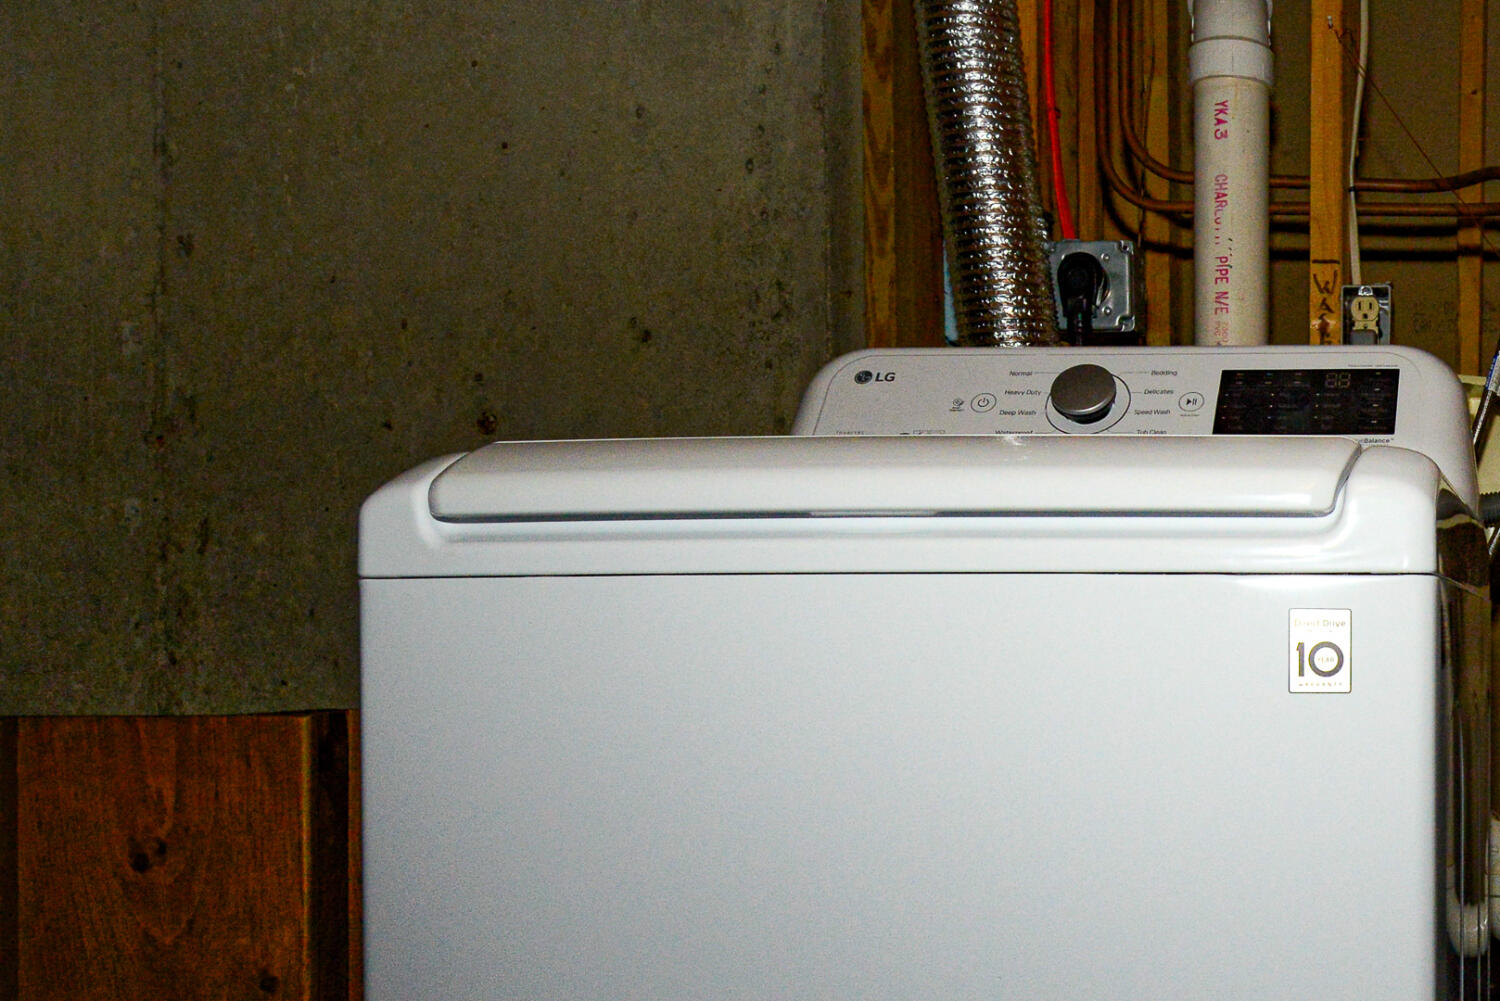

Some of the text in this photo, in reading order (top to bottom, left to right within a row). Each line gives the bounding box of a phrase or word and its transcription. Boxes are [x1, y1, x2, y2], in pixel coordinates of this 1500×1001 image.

[1214, 255, 1229, 285] PIPE
[874, 371, 896, 382] LG
[1296, 640, 1344, 678] 10
